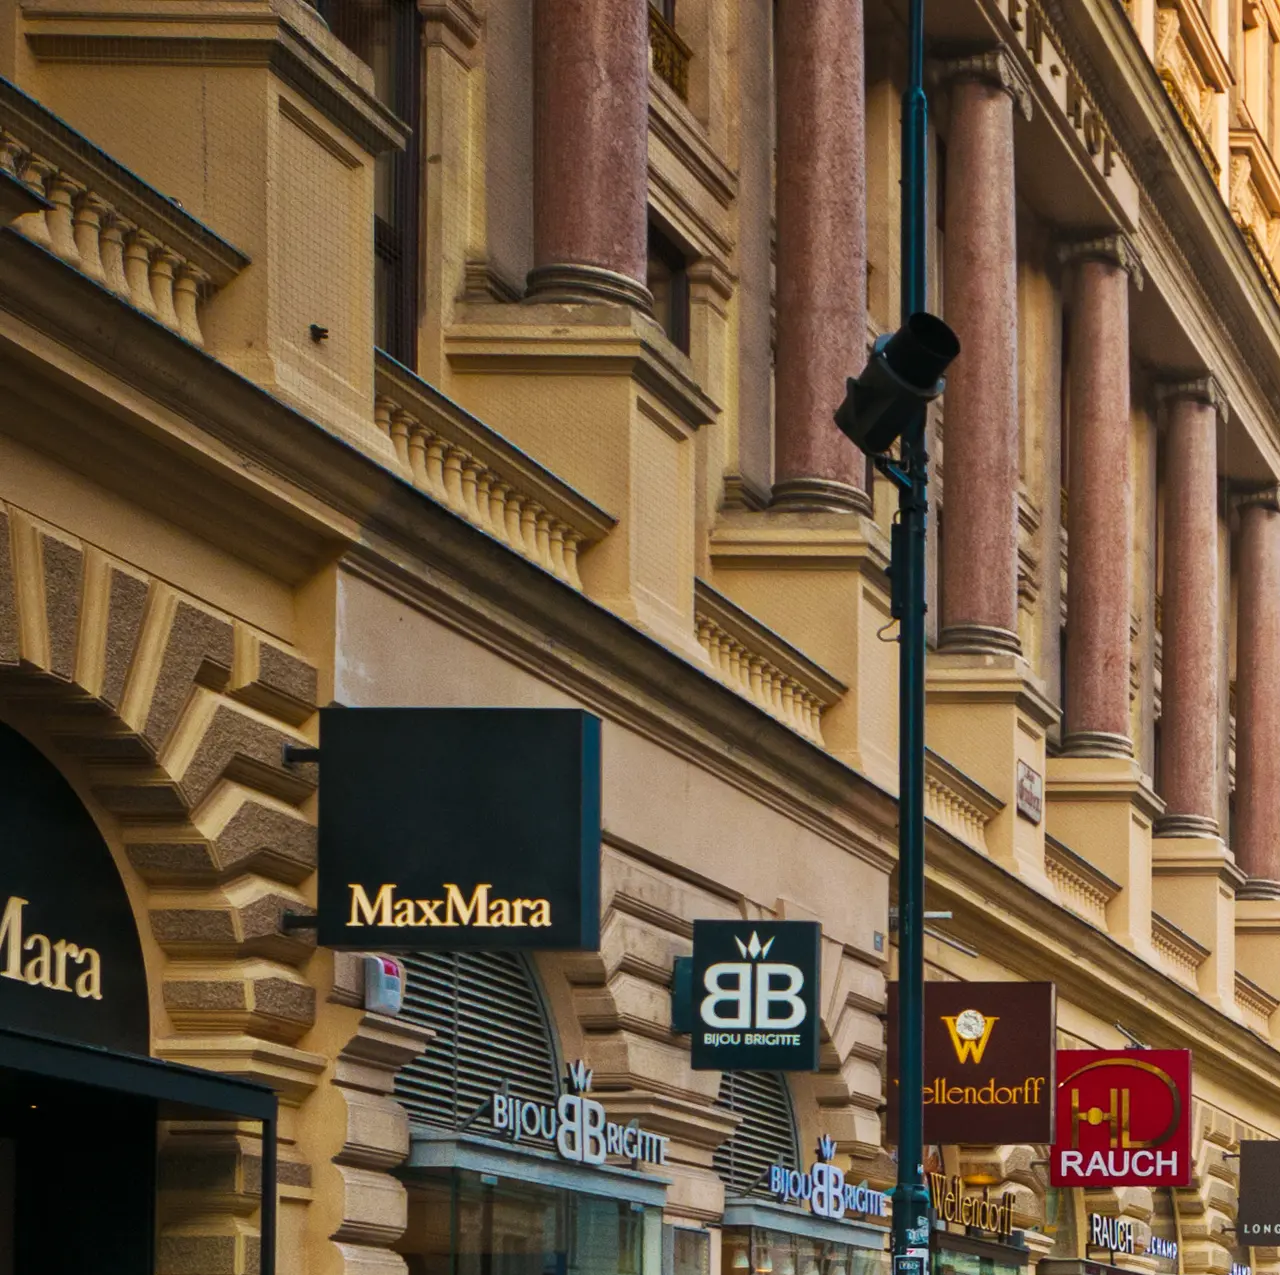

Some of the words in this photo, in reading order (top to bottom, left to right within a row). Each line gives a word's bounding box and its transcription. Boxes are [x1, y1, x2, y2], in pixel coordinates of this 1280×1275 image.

[346, 883, 553, 927] MaxMara
[703, 1032, 741, 1048] BIJOU
[744, 1032, 801, 1046] BRIGITTE
[893, 1076, 1045, 1105] ellendorff
[493, 1093, 557, 1141] BIJOU
[1061, 1150, 1178, 1177] RAUCH
[930, 1172, 1014, 1236] Wellendorff
[1091, 1213, 1134, 1254] RAUCH
